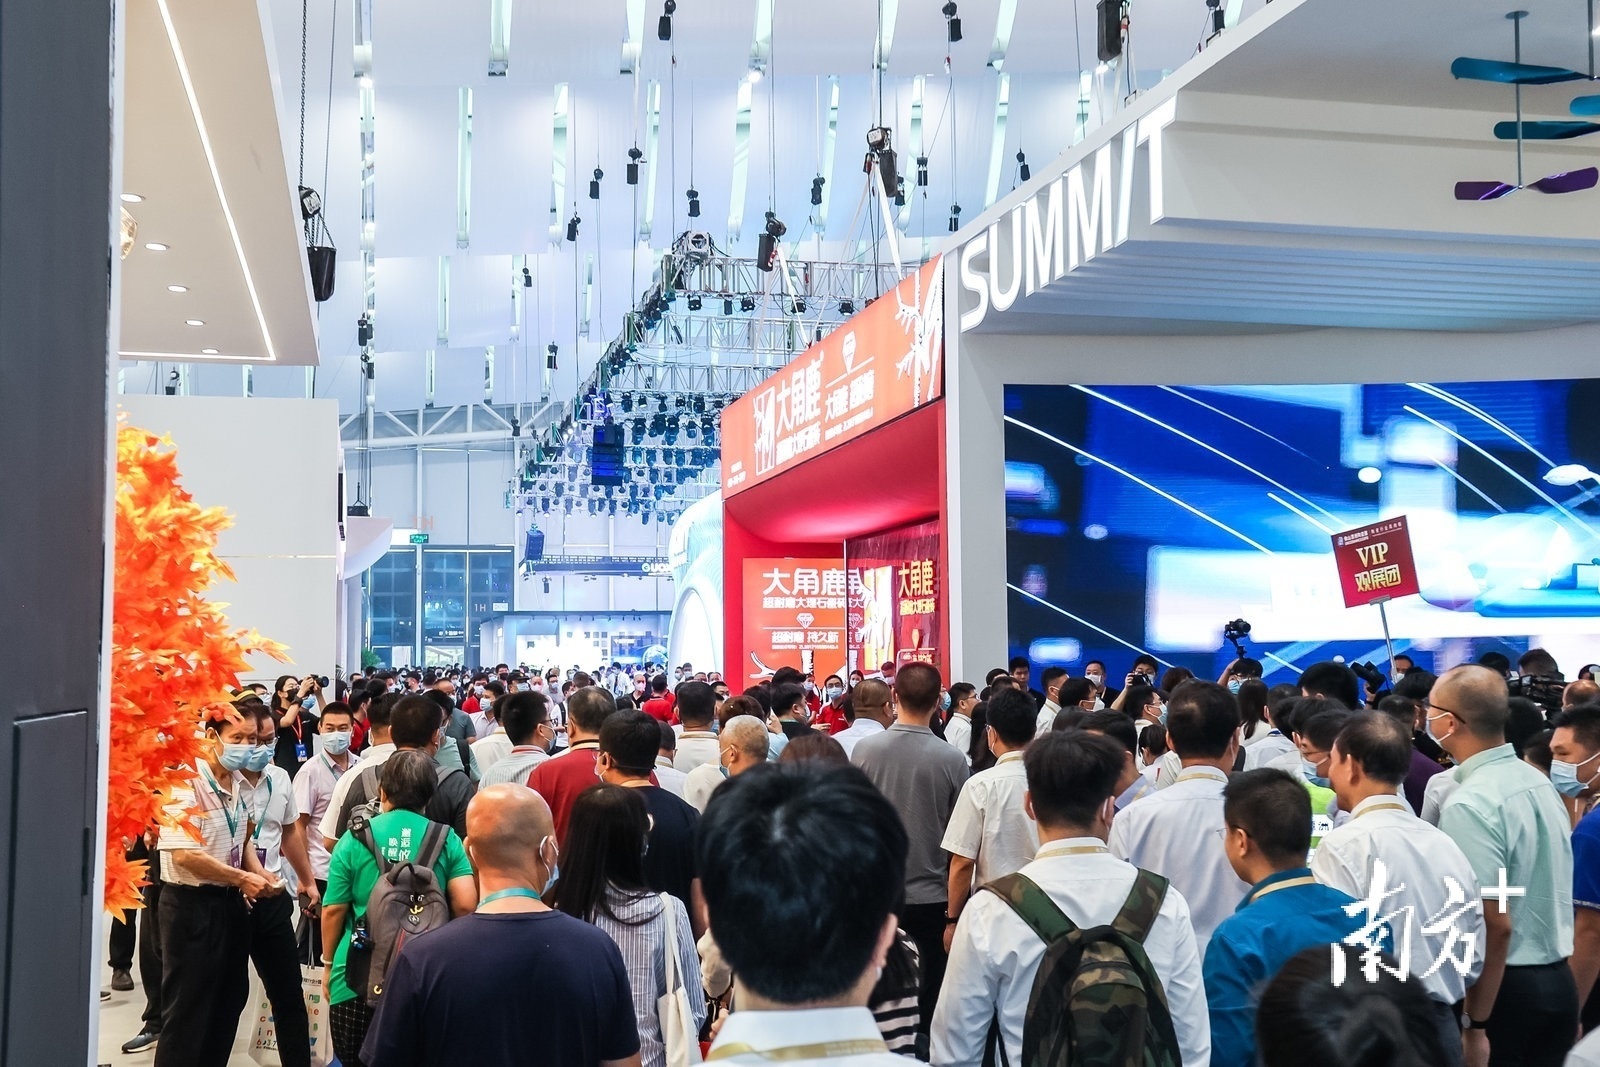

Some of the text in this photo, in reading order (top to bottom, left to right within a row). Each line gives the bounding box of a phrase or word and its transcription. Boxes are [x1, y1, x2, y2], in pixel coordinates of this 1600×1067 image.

[960, 95, 1178, 333] SUMMIT
[775, 357, 822, 438] 大角鹿
[1356, 542, 1388, 568] VIP
[762, 567, 845, 596] 大角鹿
[898, 558, 934, 599] 大角鹿
[1354, 564, 1401, 592] 观展团
[474, 603, 487, 612] 1H
[771, 631, 804, 644] 超耐磨
[807, 631, 839, 644] 持久新
